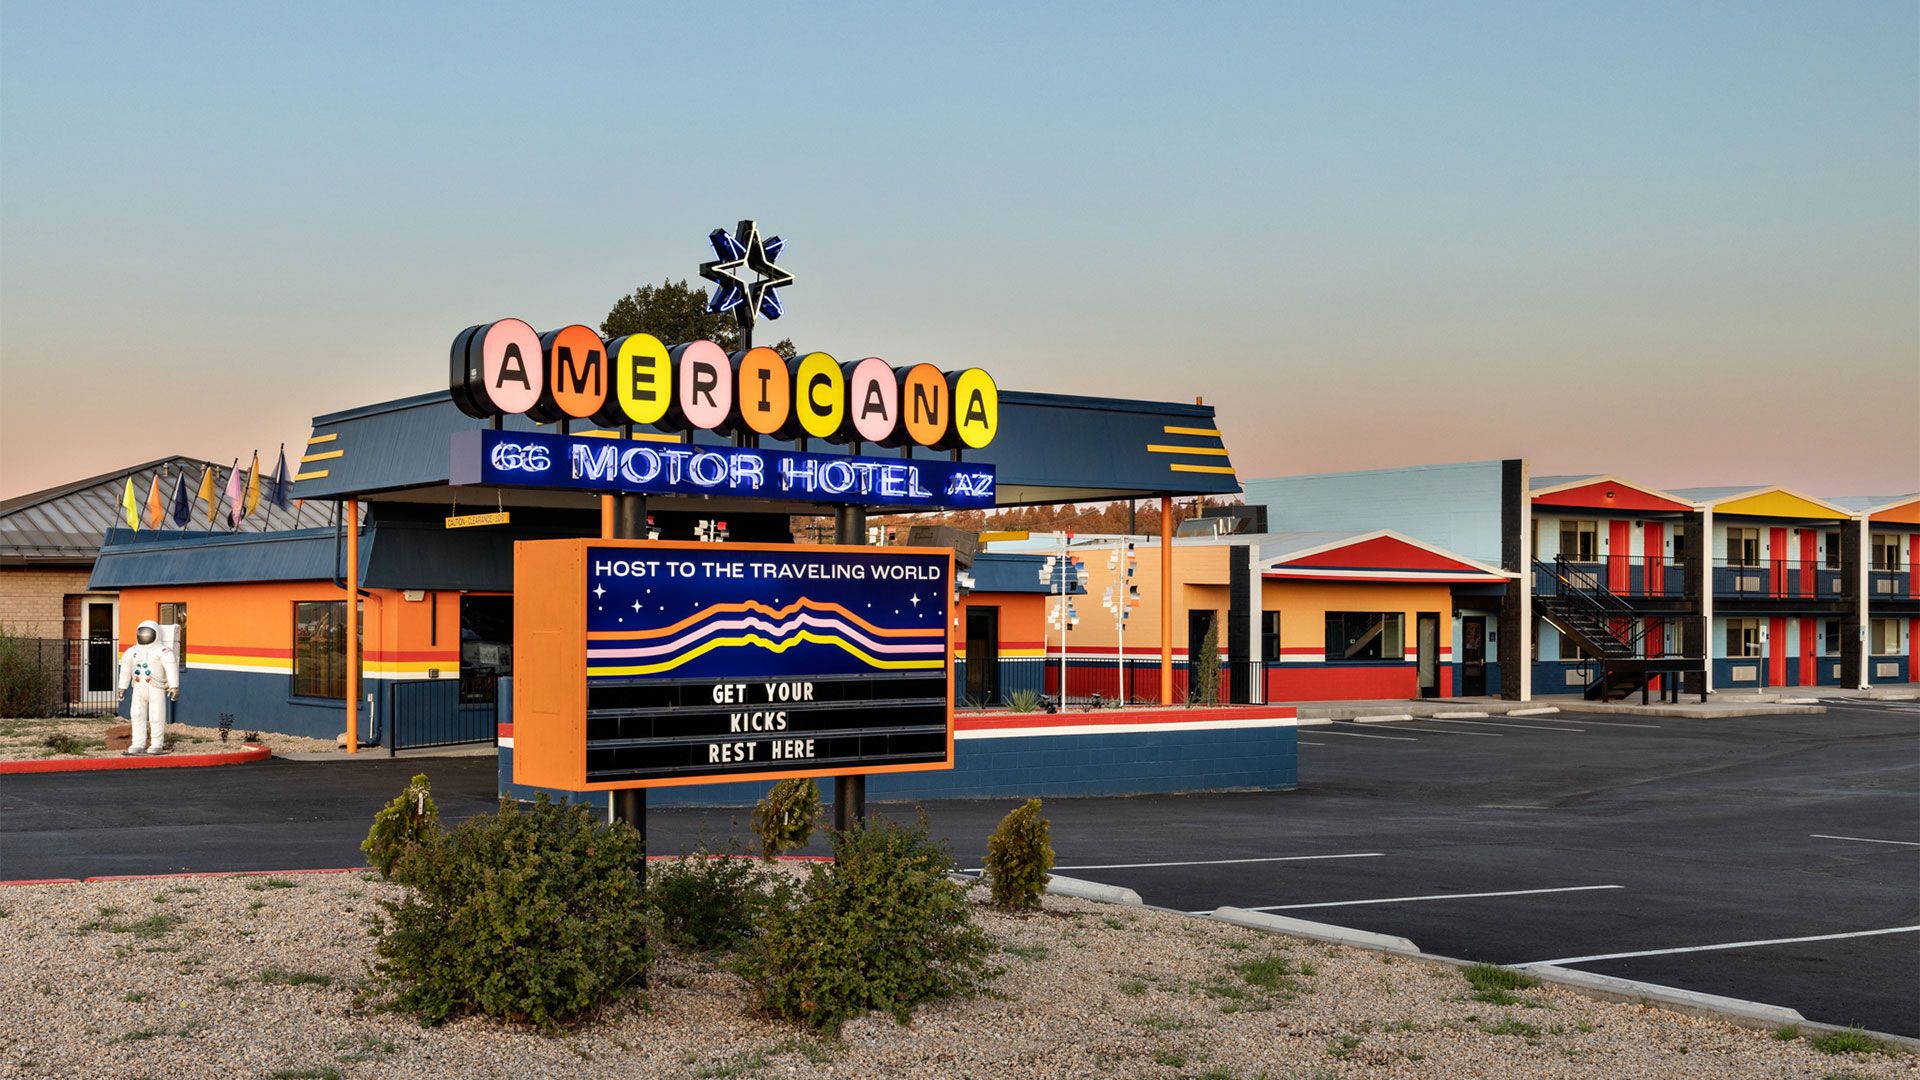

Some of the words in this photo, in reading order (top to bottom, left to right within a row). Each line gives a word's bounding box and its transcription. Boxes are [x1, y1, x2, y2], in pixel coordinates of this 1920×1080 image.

[496, 342, 989, 430] AMERICANA
[490, 441, 551, 472] 66
[570, 444, 764, 489] MOTOR
[781, 457, 933, 498] HOTEL
[946, 472, 994, 497] AZ
[596, 561, 660, 577] HOST
[666, 562, 695, 577] TO
[702, 563, 744, 577] THE
[750, 563, 864, 579] TRAVELING
[871, 565, 940, 579] WORLD
[713, 684, 746, 703] GET
[766, 682, 813, 701] YOUR
[731, 712, 786, 732] KICKS
[710, 742, 756, 762] REST
[773, 740, 814, 759] HERE
